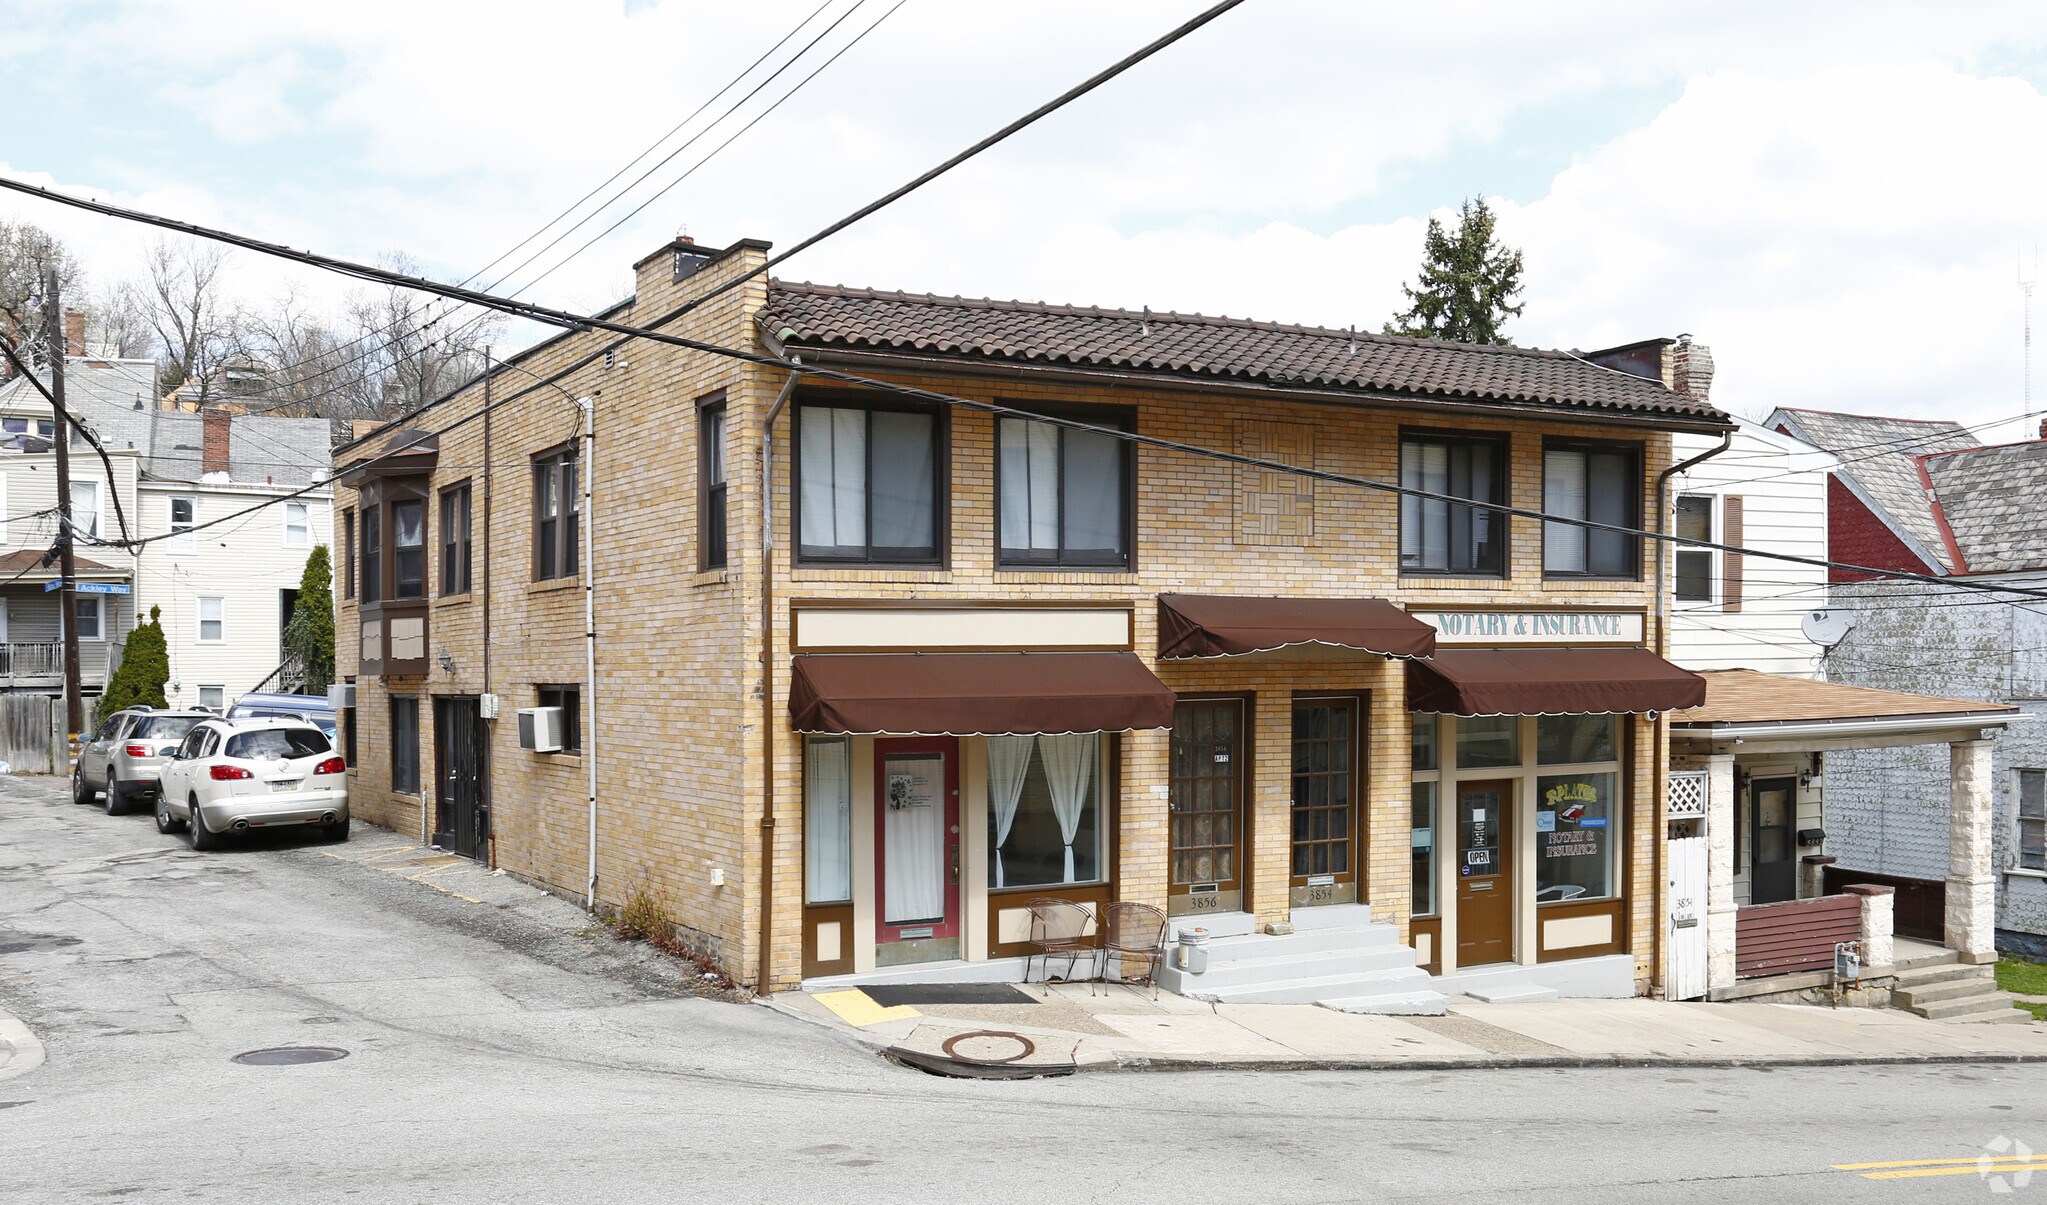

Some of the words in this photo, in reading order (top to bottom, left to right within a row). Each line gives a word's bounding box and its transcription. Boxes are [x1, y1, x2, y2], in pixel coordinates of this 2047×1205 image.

[81, 584, 107, 593] Ackley
[110, 585, 127, 593] Way
[1437, 614, 1510, 636] NOTARY
[1513, 614, 1527, 636] &
[1532, 614, 1622, 636] INSURANCE
[1548, 830, 1584, 844] NOTARY
[1586, 830, 1595, 841] &
[1546, 843, 1597, 857] INSURANCE
[1470, 851, 1489, 863] OPEN
[1309, 889, 1332, 901] 3854
[1191, 896, 1217, 909] 3856
